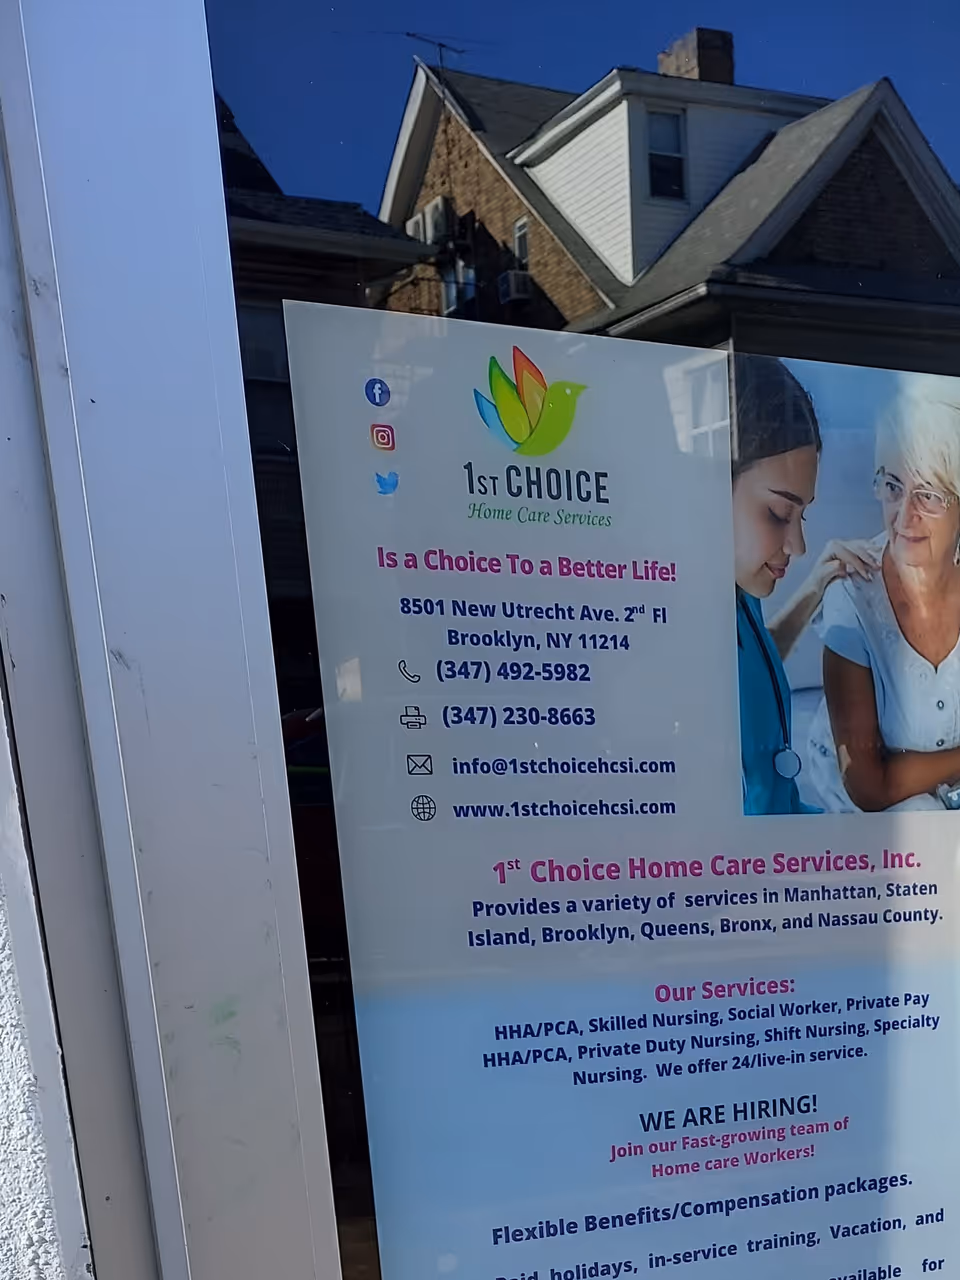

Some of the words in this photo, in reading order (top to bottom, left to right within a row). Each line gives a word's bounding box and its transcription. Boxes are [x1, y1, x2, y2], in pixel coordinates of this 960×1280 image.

[463, 462, 498, 496] 1ST
[506, 465, 609, 504] CHOICE
[468, 503, 512, 520] Home
[518, 507, 550, 523] Care
[554, 509, 611, 526] Services
[378, 547, 398, 568] Is
[404, 553, 418, 569] a
[424, 549, 501, 573] Choice
[506, 554, 533, 574] To
[540, 560, 552, 575] a
[558, 557, 627, 579] Better
[632, 560, 676, 582] Life!
[400, 598, 444, 615] 8501
[452, 600, 496, 617] New
[502, 602, 575, 620] Utrecht
[580, 605, 619, 622] Ave.
[624, 604, 645, 622] 2nd
[653, 607, 666, 623] Fl
[448, 629, 540, 652] Brooklyn,
[546, 633, 572, 648] NY
[578, 634, 630, 650] 11214
[437, 660, 491, 683] (347)
[497, 662, 590, 681] 492-5982
[443, 706, 496, 728] (347)
[503, 707, 595, 725] 230-8663
[452, 757, 675, 775] info@1stchoicehcsi.com
[453, 799, 675, 817] www.1stchoicehcsi.com
[493, 859, 521, 884] 1st
[531, 858, 620, 882] Choice
[629, 858, 702, 879] Home
[711, 855, 765, 876] Care
[773, 850, 875, 873] Services,
[883, 849, 921, 868] Inc.
[473, 898, 560, 917] Provides
[566, 900, 577, 913] a
[582, 894, 651, 914] variety
[657, 892, 675, 908] of
[685, 889, 757, 907] services
[763, 888, 778, 903] in
[784, 885, 881, 902] Manhattan,
[886, 883, 937, 897] Staten
[468, 927, 536, 946] Island,
[542, 923, 635, 944] Brooklyn,
[641, 922, 714, 940] Queens,
[721, 918, 776, 933] Bronx,
[782, 913, 813, 929] and
[819, 913, 878, 927] Nassau
[883, 908, 943, 925] County.
[655, 985, 696, 1002] Our
[702, 977, 794, 999] Services:
[495, 1020, 583, 1040] HHA/PCA,
[589, 1014, 647, 1033] Skilled
[653, 1010, 723, 1027] Nursing,
[728, 1004, 775, 1021] Social
[779, 1000, 841, 1016] Worker,
[847, 996, 899, 1011] Private
[904, 993, 929, 1008] Pay
[483, 1047, 572, 1068] HHA/PCA,
[578, 1042, 641, 1059] Private
[646, 1038, 686, 1054] Duty
[691, 1032, 759, 1049] Nursing,
[765, 1026, 801, 1042] Shift
[806, 1021, 869, 1038] Nursing,
[874, 1014, 940, 1035] Specialty
[573, 1067, 647, 1085] Nursing.
[656, 1063, 683, 1077] We
[688, 1058, 728, 1074] offer
[732, 1050, 805, 1070] 24/live-in
[810, 1045, 868, 1062] service.
[639, 1110, 675, 1132] WE
[682, 1105, 725, 1128] ARE
[733, 1094, 817, 1122] HIRING!
[609, 1142, 643, 1162] Join
[649, 1141, 677, 1153] our
[682, 1126, 786, 1150] Fast-growing
[790, 1122, 829, 1136] team
[834, 1116, 849, 1131] of
[652, 1162, 700, 1177] Home
[705, 1157, 739, 1170] care
[744, 1144, 814, 1165] Workers!
[492, 1219, 578, 1245] Flexible
[585, 1186, 818, 1234] Benefits/Compensation
[825, 1174, 912, 1202] packages.
[649, 1243, 737, 1268] in-service
[747, 1231, 820, 1252] training,
[830, 1218, 906, 1239] Vacation,
[915, 1208, 944, 1225] and
[922, 1259, 945, 1272] for
